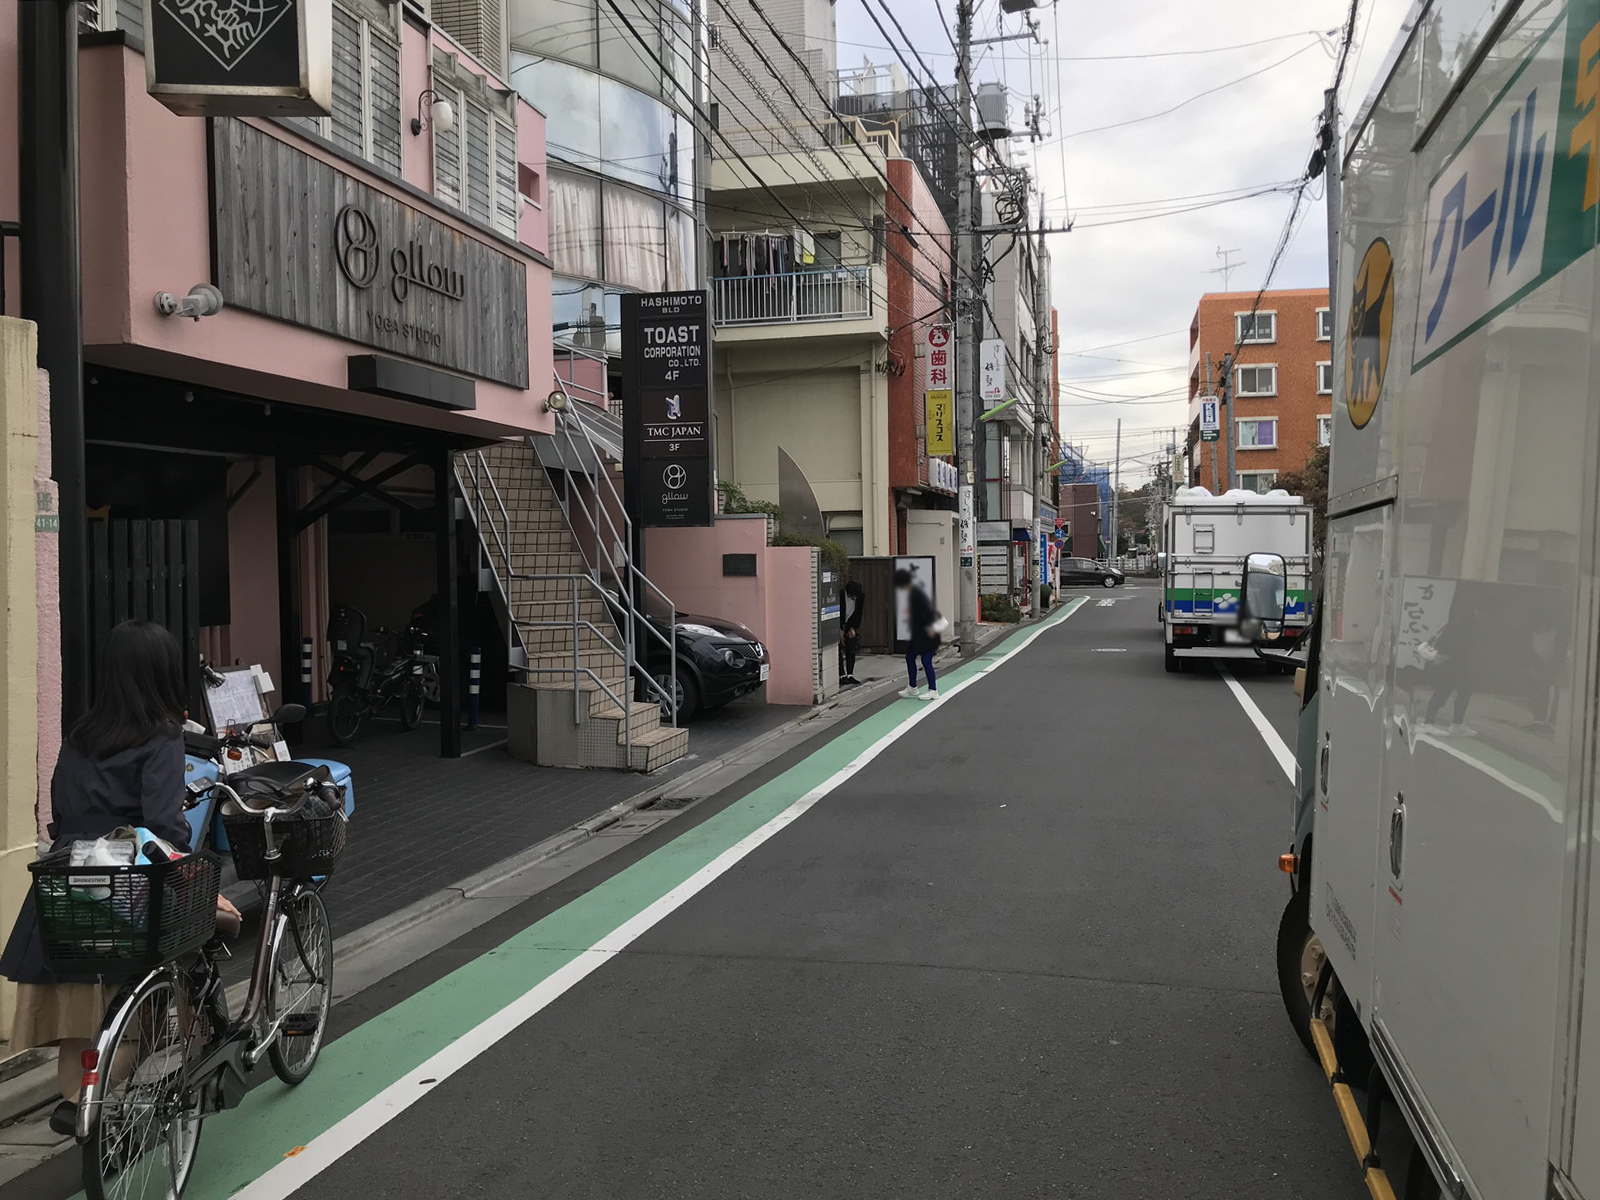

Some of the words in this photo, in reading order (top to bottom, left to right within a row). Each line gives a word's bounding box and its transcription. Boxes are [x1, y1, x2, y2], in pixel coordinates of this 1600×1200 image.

[1425, 86, 1547, 345] クール
[641, 295, 702, 307] HASHIMOTO
[662, 306, 680, 314] BLD
[366, 310, 400, 335] YOGA
[402, 322, 442, 348] STUDIO
[643, 325, 700, 344] TOAST
[644, 345, 701, 358] CORPORATION
[930, 349, 947, 385] 歯科
[664, 371, 680, 381] 4F
[935, 403, 944, 442] マリスコス
[647, 427, 670, 437] TMC
[671, 426, 701, 438] JAPAN
[668, 443, 681, 452] 3F
[36, 518, 58, 528] 41-14
